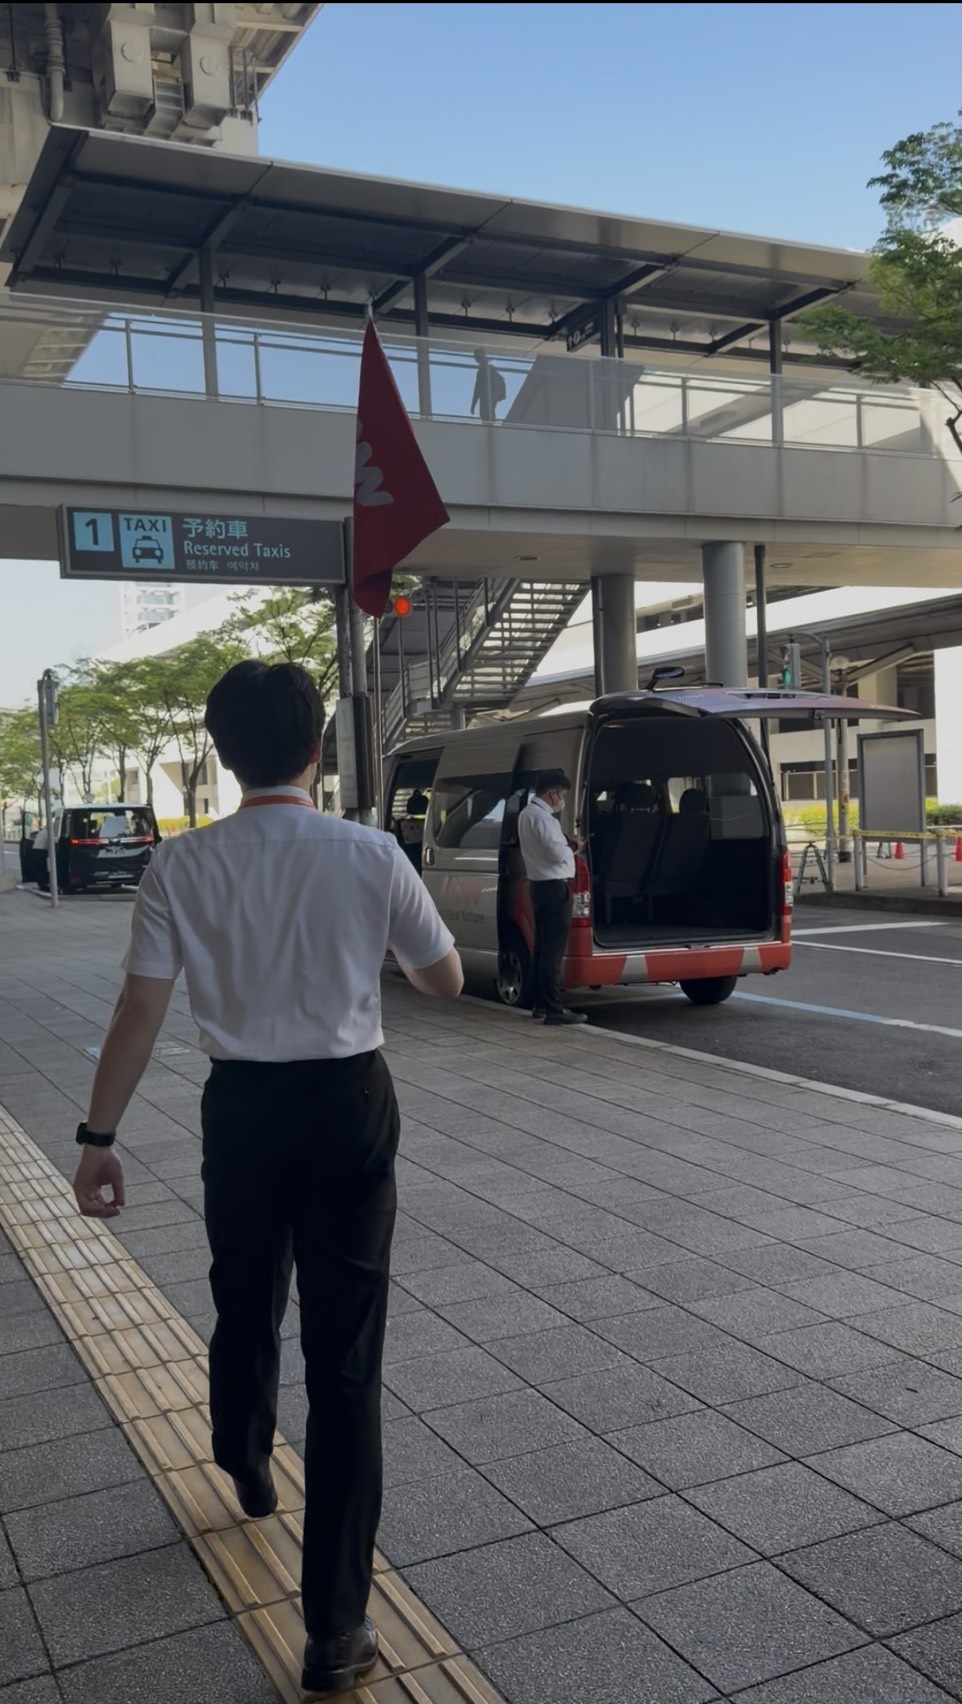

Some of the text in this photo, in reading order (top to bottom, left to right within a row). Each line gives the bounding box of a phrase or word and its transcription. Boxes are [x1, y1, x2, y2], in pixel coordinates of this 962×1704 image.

[85, 518, 99, 546] 1
[123, 517, 167, 532] TAXI
[182, 518, 249, 539] 予約車
[183, 540, 292, 558] Reserved Taxis
